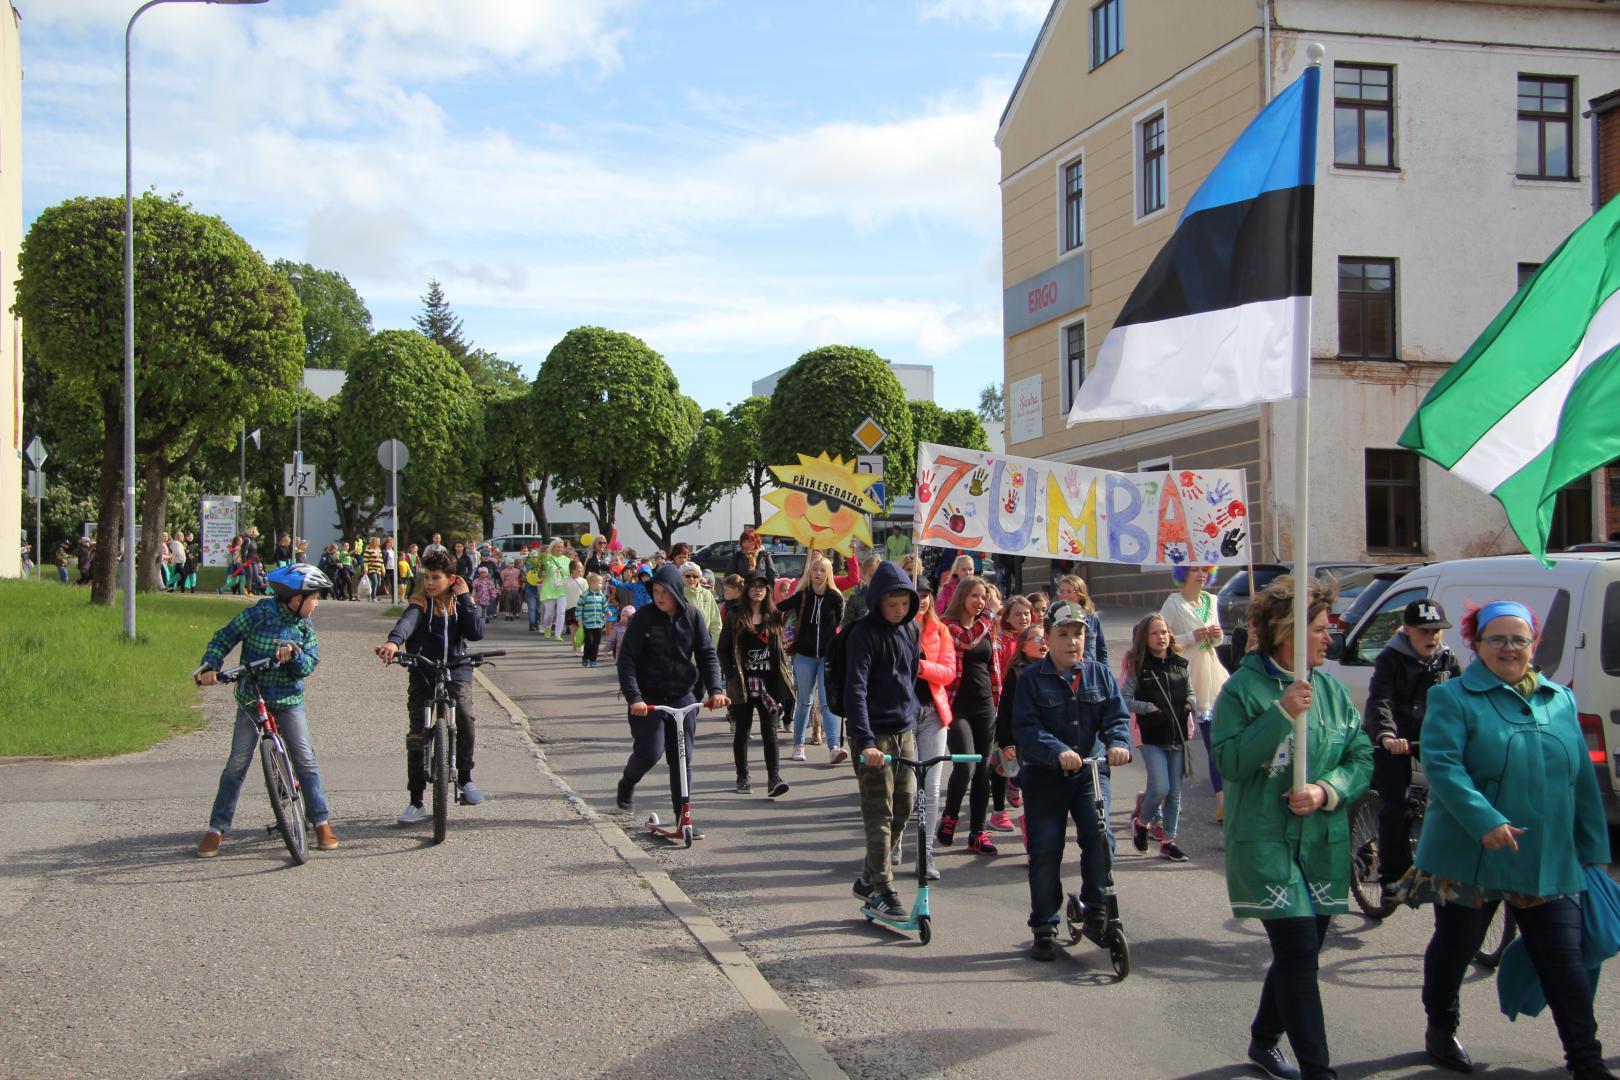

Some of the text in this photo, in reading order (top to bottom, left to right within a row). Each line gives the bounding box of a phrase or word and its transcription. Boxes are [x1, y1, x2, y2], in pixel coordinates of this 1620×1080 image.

[1028, 281, 1058, 314] ERGO
[792, 474, 864, 508] PÄIKESERATAS
[921, 455, 1198, 564] ZUMBA
[1418, 603, 1441, 621] LA
[917, 789, 926, 827] district
